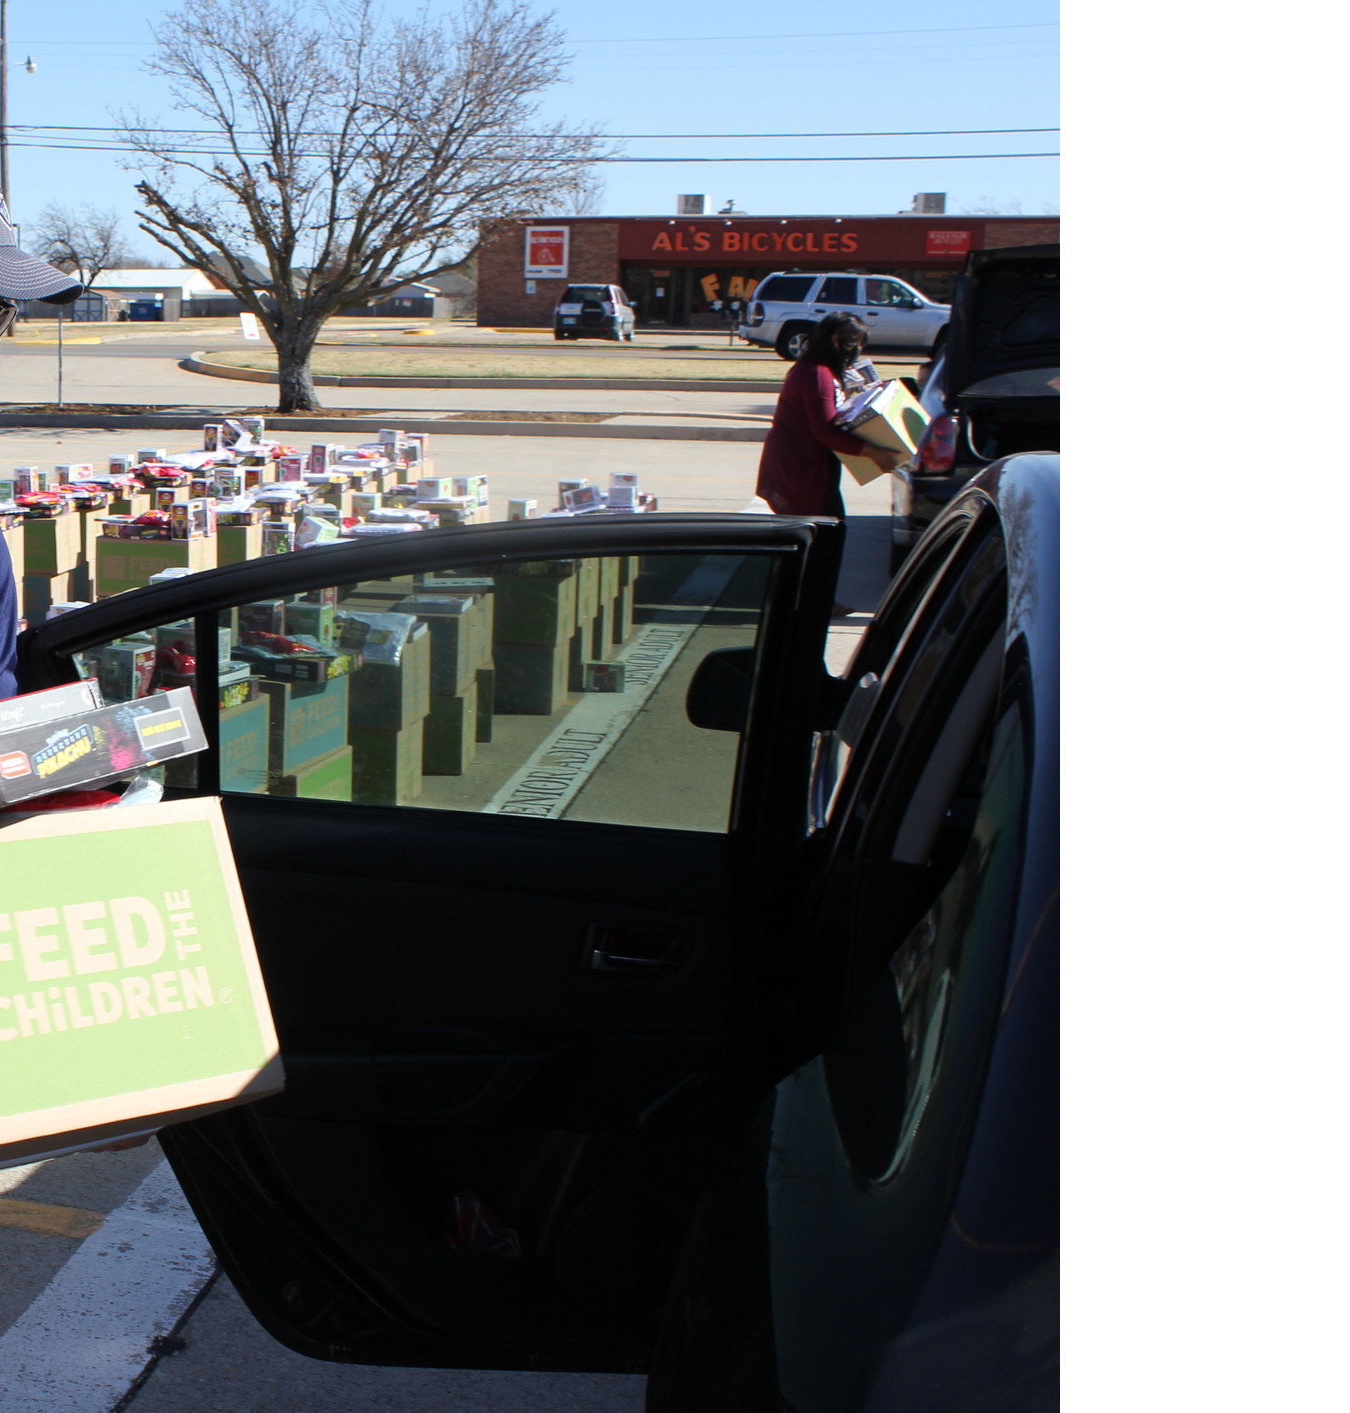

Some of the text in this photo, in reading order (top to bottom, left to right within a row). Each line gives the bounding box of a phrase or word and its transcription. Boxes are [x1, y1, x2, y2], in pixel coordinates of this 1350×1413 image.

[651, 226, 858, 252] AL'S BICYCLES
[36, 735, 92, 778] PIKACHU
[498, 771, 579, 819] ENIOR
[163, 889, 203, 961] THE
